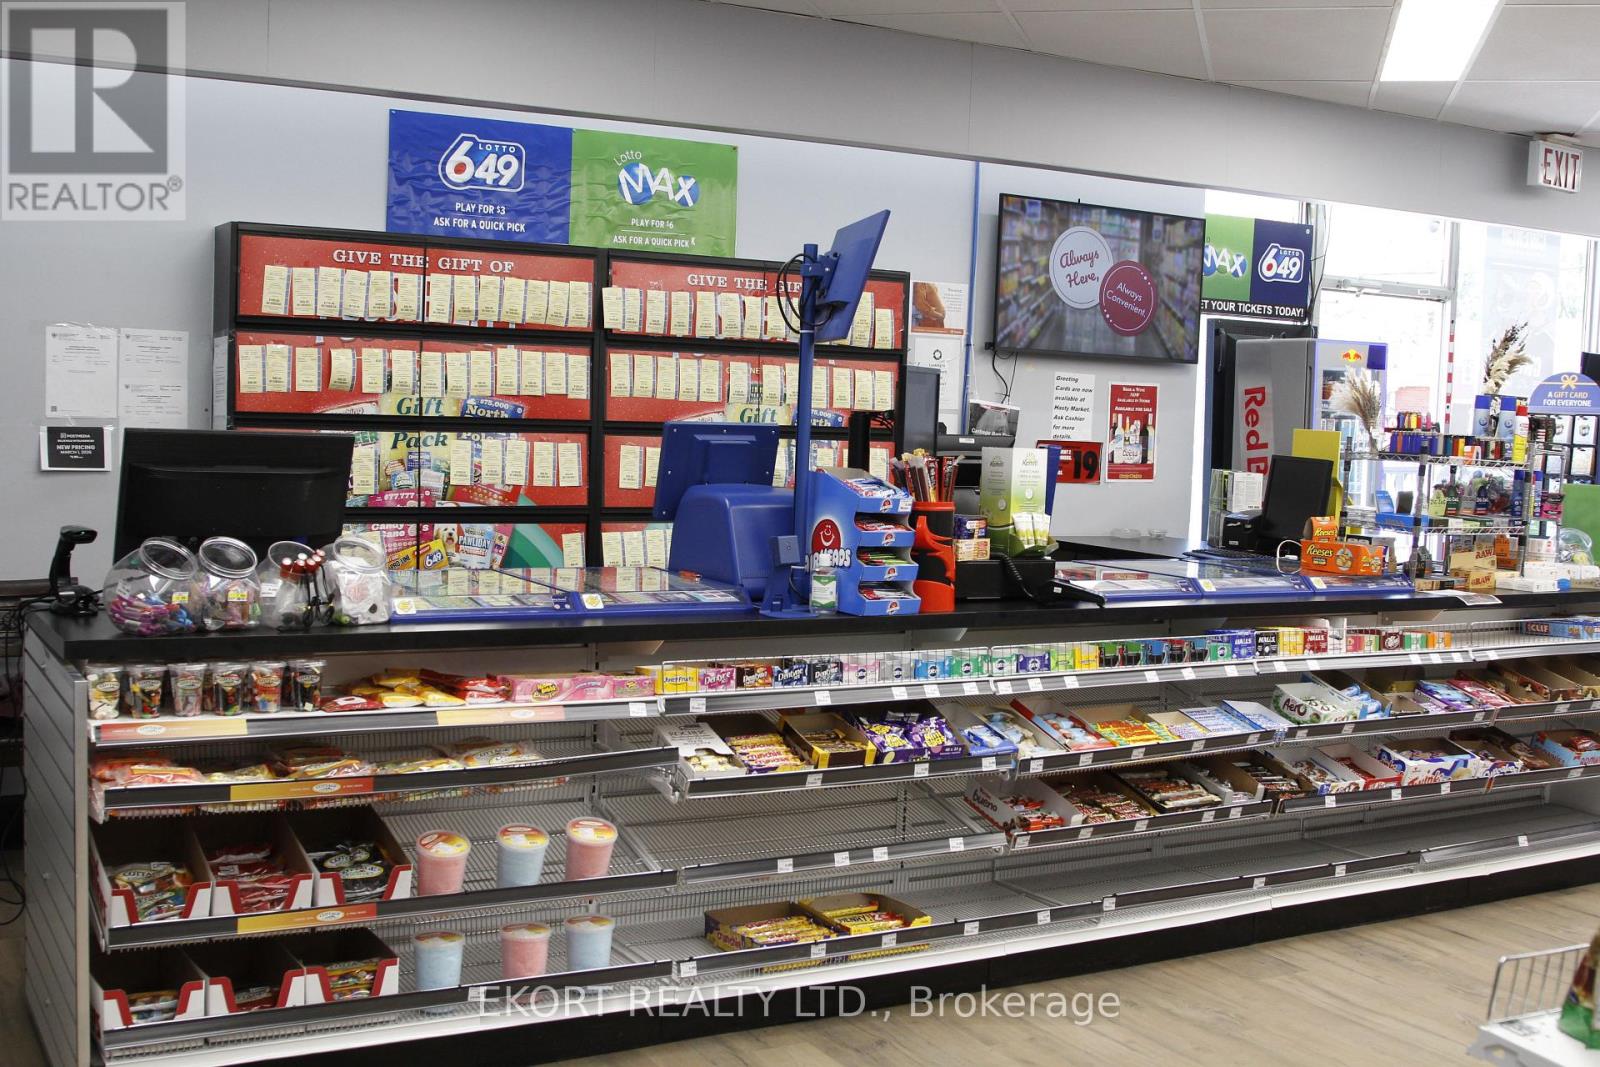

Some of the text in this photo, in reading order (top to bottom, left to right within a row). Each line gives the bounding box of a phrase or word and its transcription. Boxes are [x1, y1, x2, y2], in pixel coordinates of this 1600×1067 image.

[478, 143, 517, 154] LOTTO
[446, 141, 519, 187] 649
[613, 150, 642, 167] Lotto
[1543, 147, 1580, 190] EXIT
[618, 163, 697, 207] MAX
[455, 202, 506, 215] PLAY FOR $3
[433, 217, 526, 233] ASK FOR A QUICK PICK
[631, 218, 648, 228] PLAY
[649, 219, 664, 229] FOR
[613, 236, 690, 248] ASK FOR A QUICK PICK
[333, 248, 514, 273] GIVE THE GIFT OF
[1059, 249, 1100, 269] Always
[1261, 247, 1301, 279] 649
[687, 274, 728, 288] GIVE
[734, 277, 768, 290] THE
[1066, 271, 1099, 289] Here,
[1116, 282, 1143, 302] Always
[1210, 300, 1236, 312] YOUR
[1236, 302, 1273, 315] TICKETS
[1274, 305, 1304, 318] TODAY!
[1553, 391, 1569, 399] GIFT
[397, 396, 444, 417] Gift
[466, 404, 509, 418] North
[740, 407, 777, 424] Gift
[1244, 386, 1269, 452] Red
[390, 431, 449, 450] Pack
[1073, 449, 1099, 480] 19
[1530, 624, 1549, 633] CLIF
[1282, 697, 1308, 717] Aero
[972, 788, 998, 812] bueno
